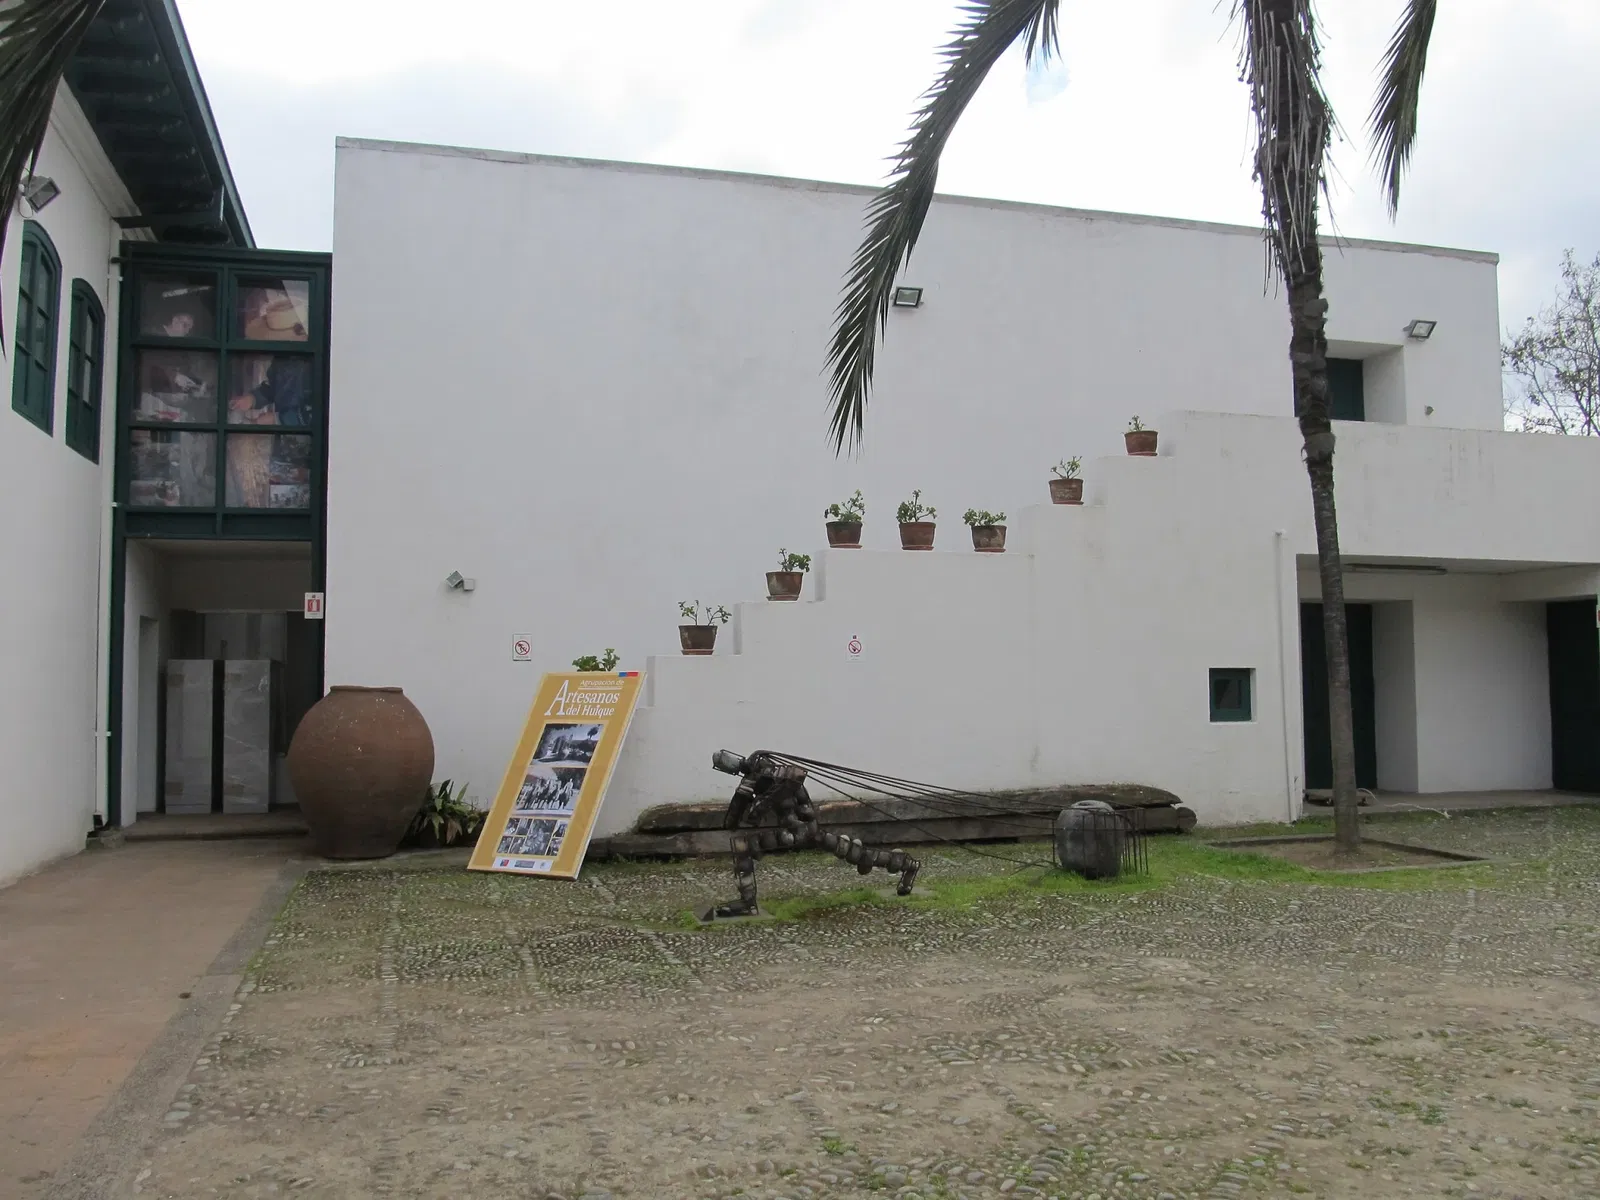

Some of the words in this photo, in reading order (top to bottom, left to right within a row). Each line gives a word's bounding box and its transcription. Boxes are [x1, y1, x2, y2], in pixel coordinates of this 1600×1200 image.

[544, 680, 620, 716] Artesanos
[566, 704, 581, 716] del
[582, 704, 615, 718] Huique
